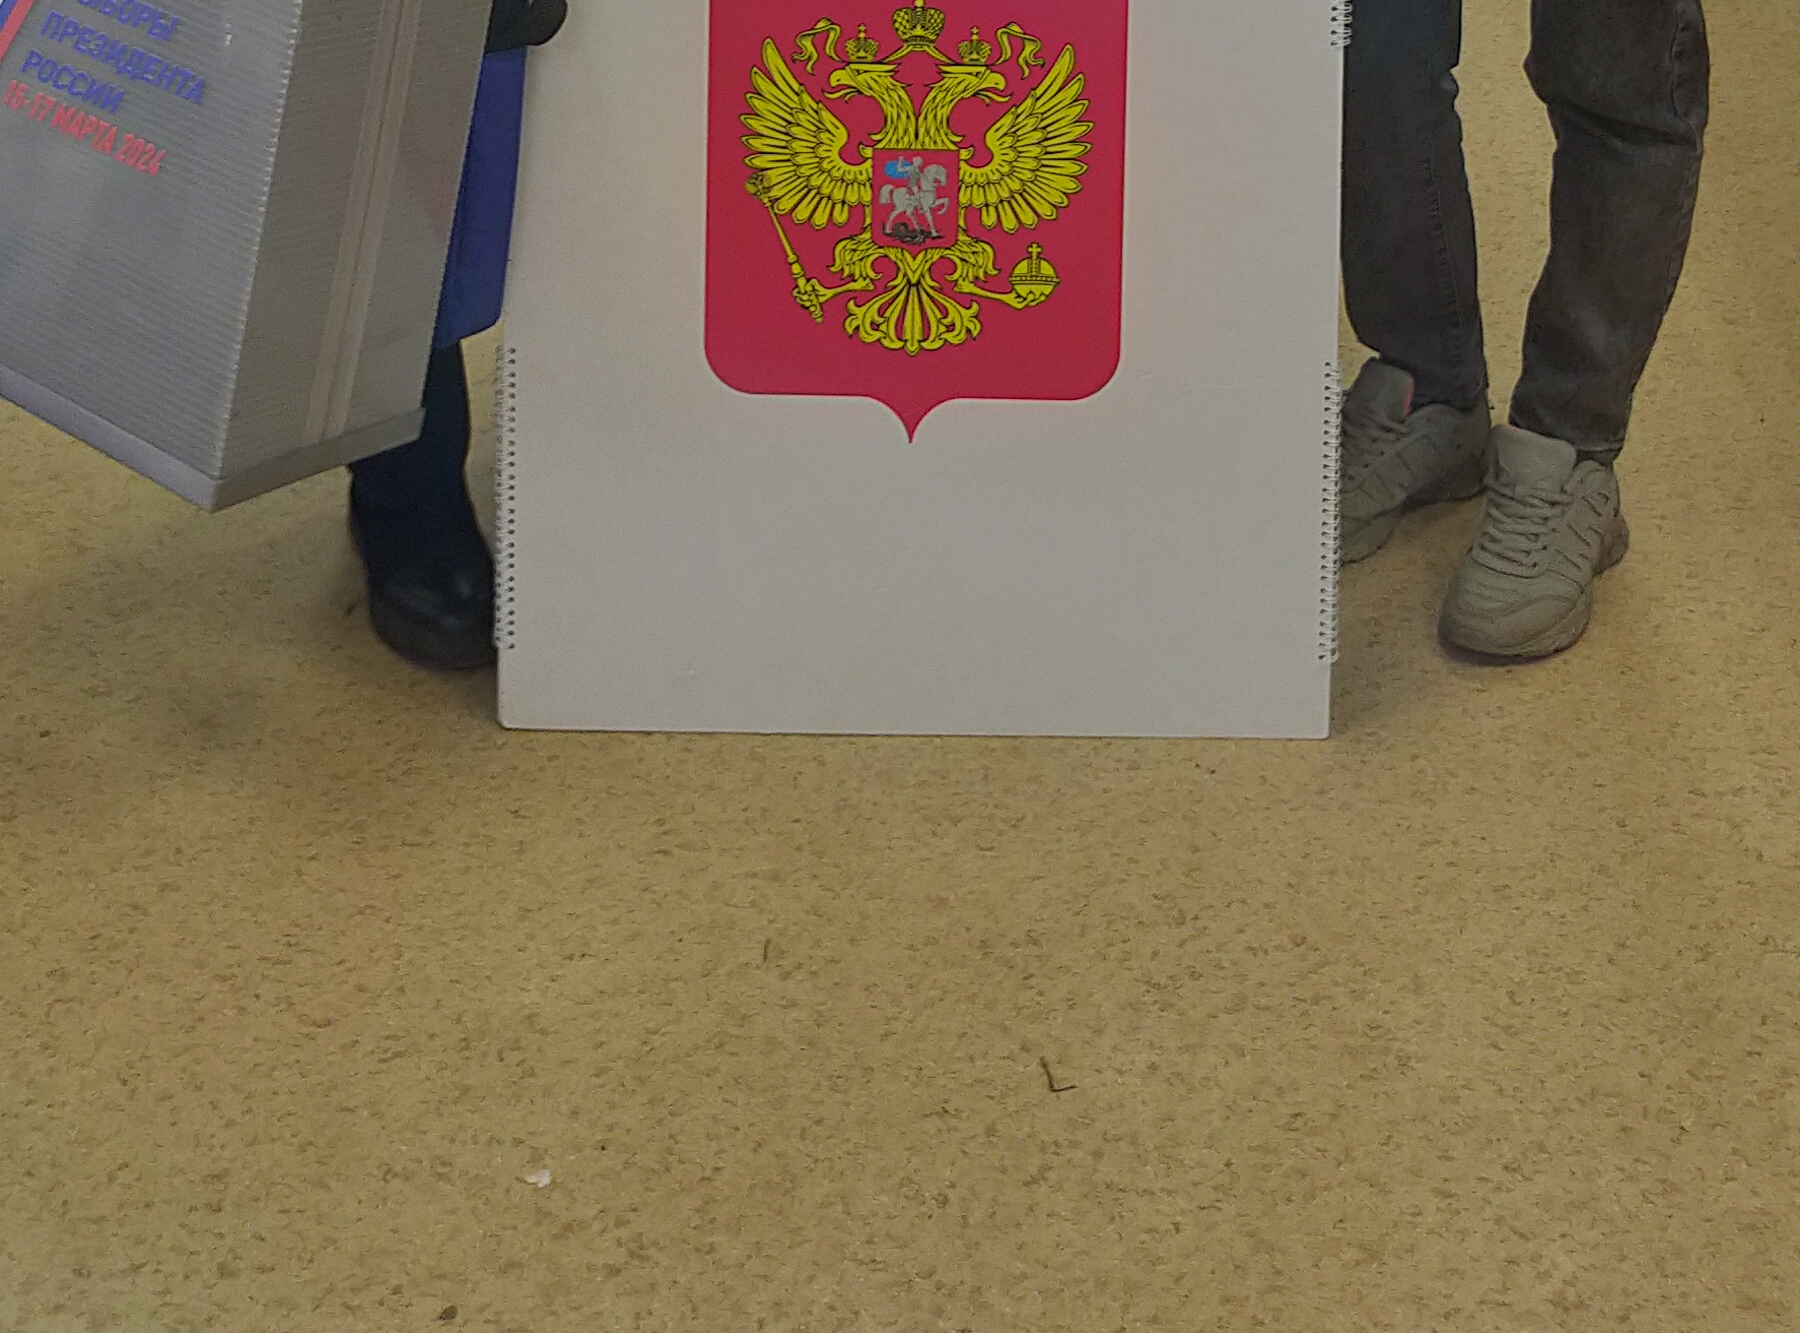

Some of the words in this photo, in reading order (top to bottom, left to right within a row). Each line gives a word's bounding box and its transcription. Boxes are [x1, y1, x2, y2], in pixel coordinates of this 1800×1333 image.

[19, 49, 126, 114] РОССИИ
[40, 9, 205, 105] ПРЕЗИДЕНТА
[3, 79, 56, 122] 15-17
[51, 102, 118, 155] МАРТА
[114, 133, 167, 177] 2024
